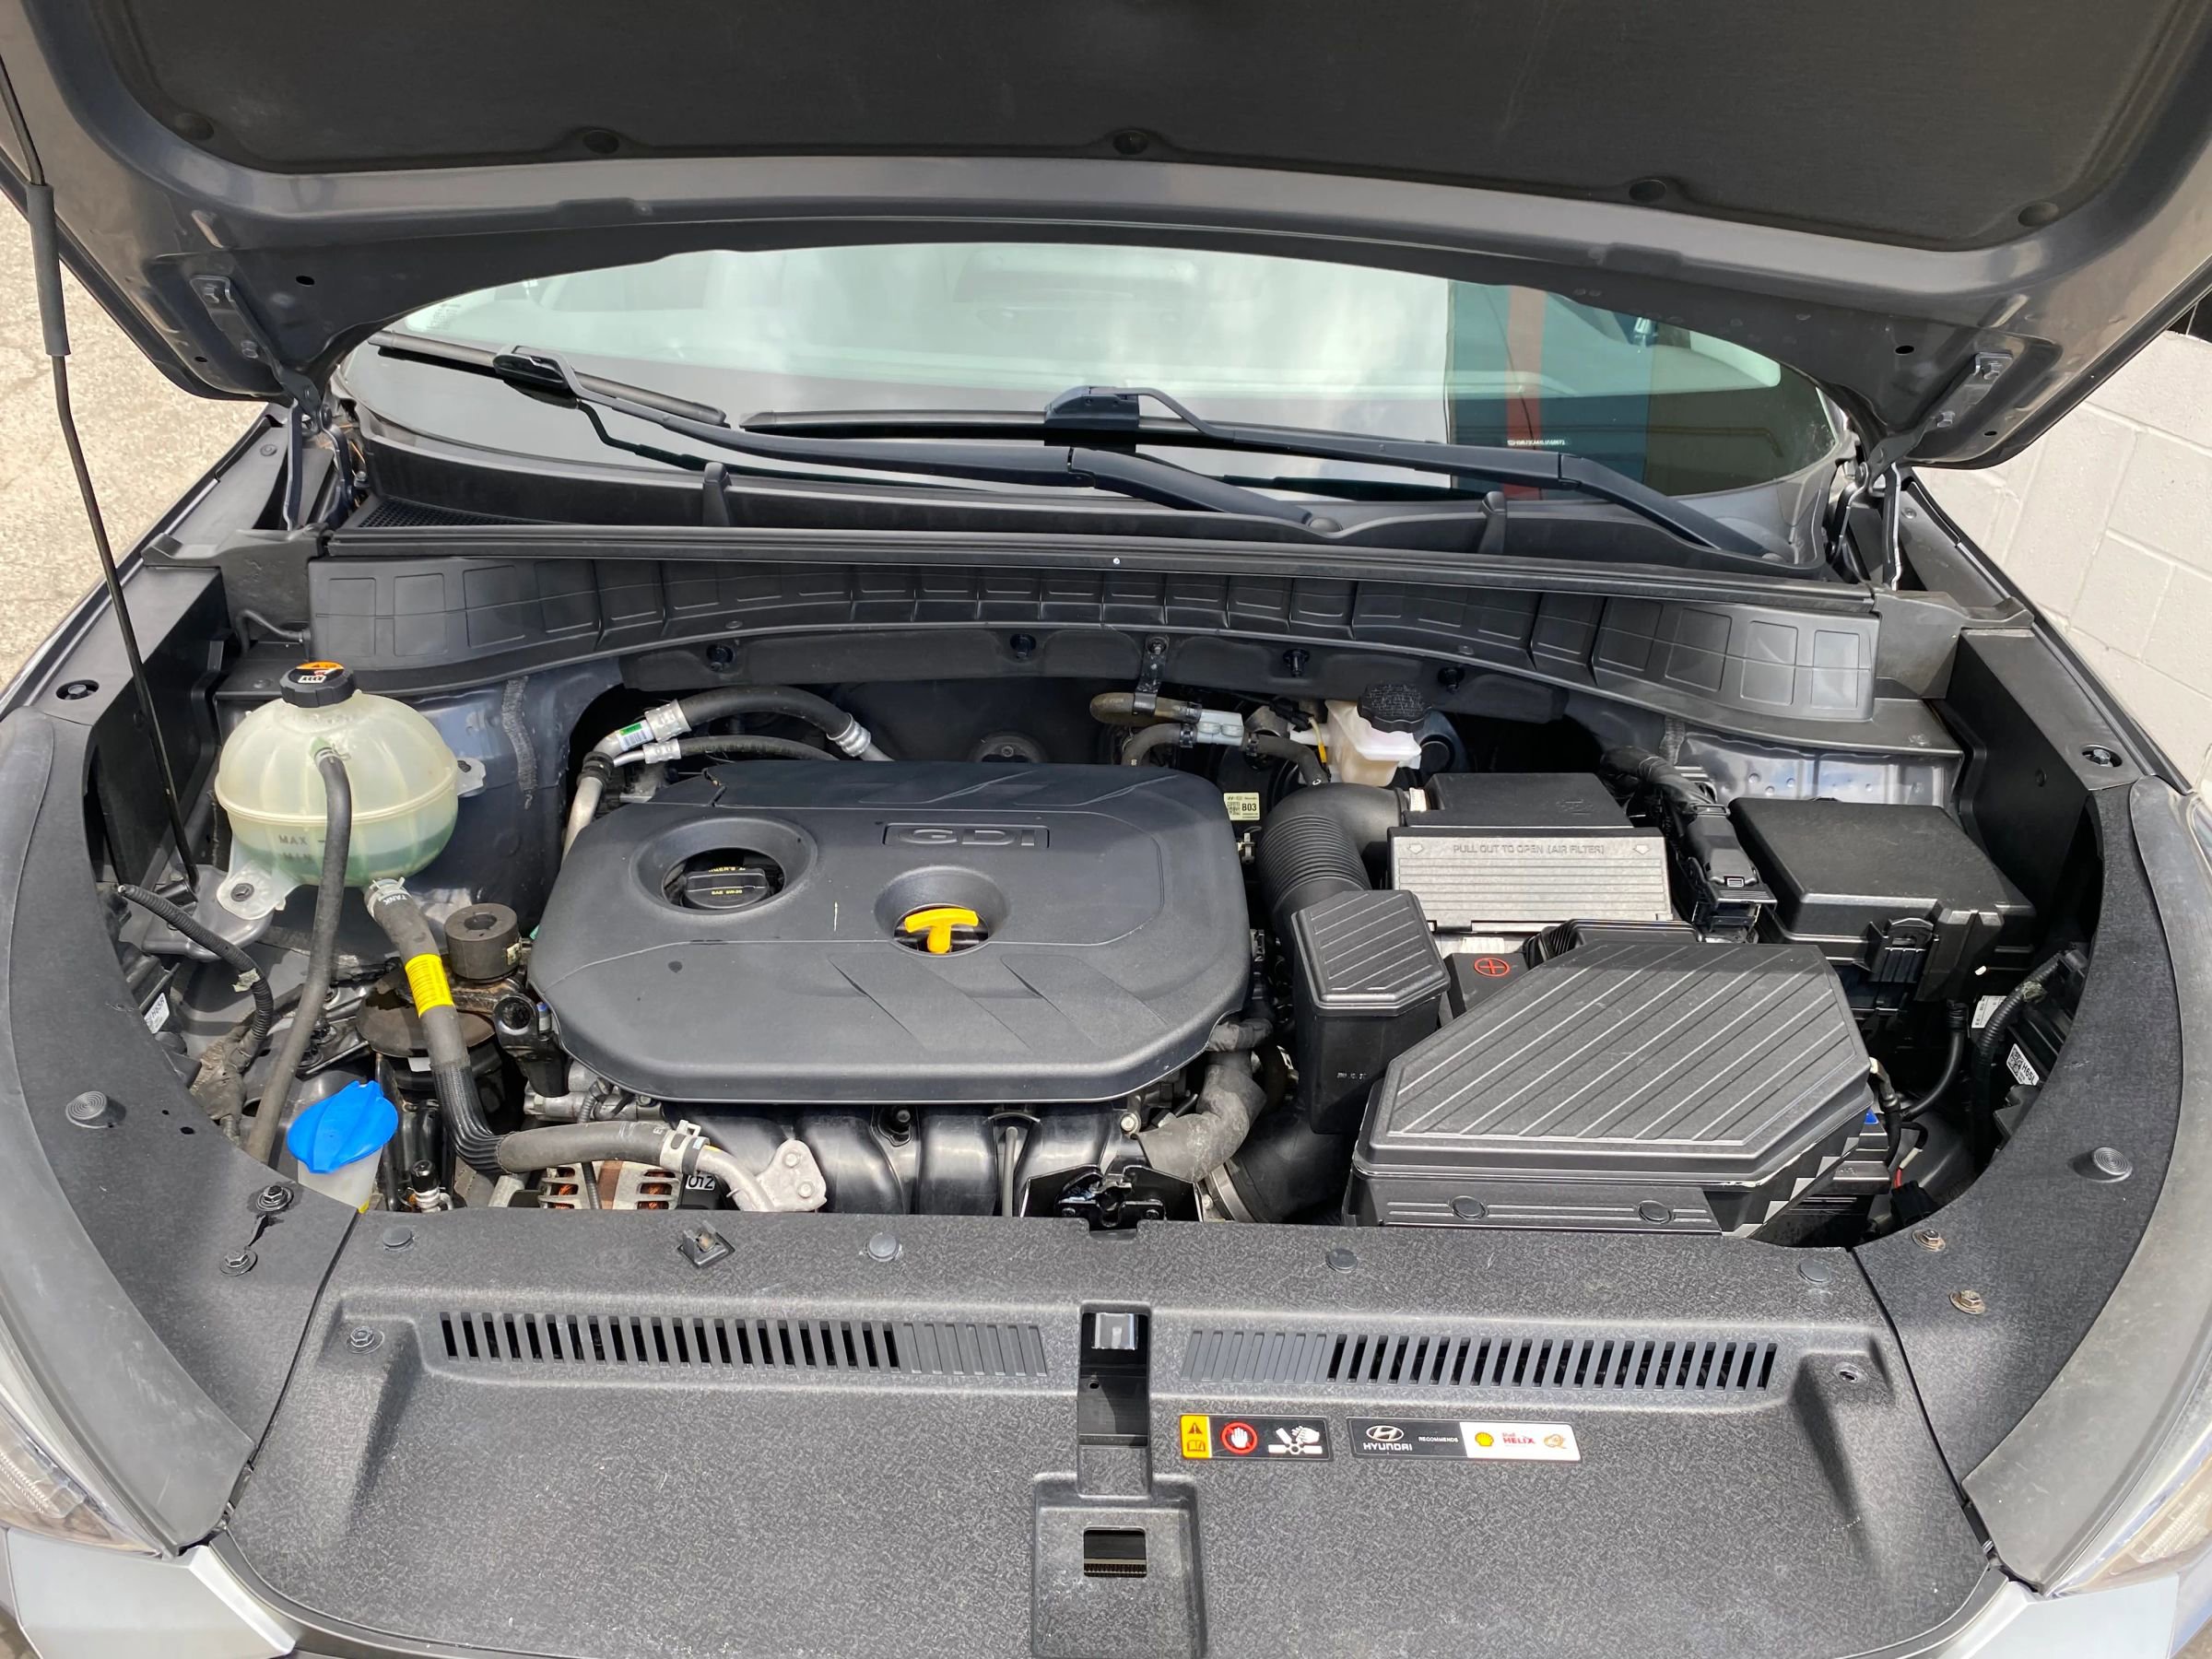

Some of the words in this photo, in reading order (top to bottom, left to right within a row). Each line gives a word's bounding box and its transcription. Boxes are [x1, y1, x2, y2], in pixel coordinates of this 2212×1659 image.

[1241, 803, 1257, 811] B03
[279, 834, 308, 845] MAX
[899, 829, 1035, 846] GDI
[1453, 844, 1477, 853] PULL
[1479, 844, 1500, 853] OUT
[1501, 844, 1514, 853] TO
[1516, 844, 1543, 853] OPEN
[382, 894, 407, 905] TANK
[1363, 1442, 1413, 1452] HYUNDAI
